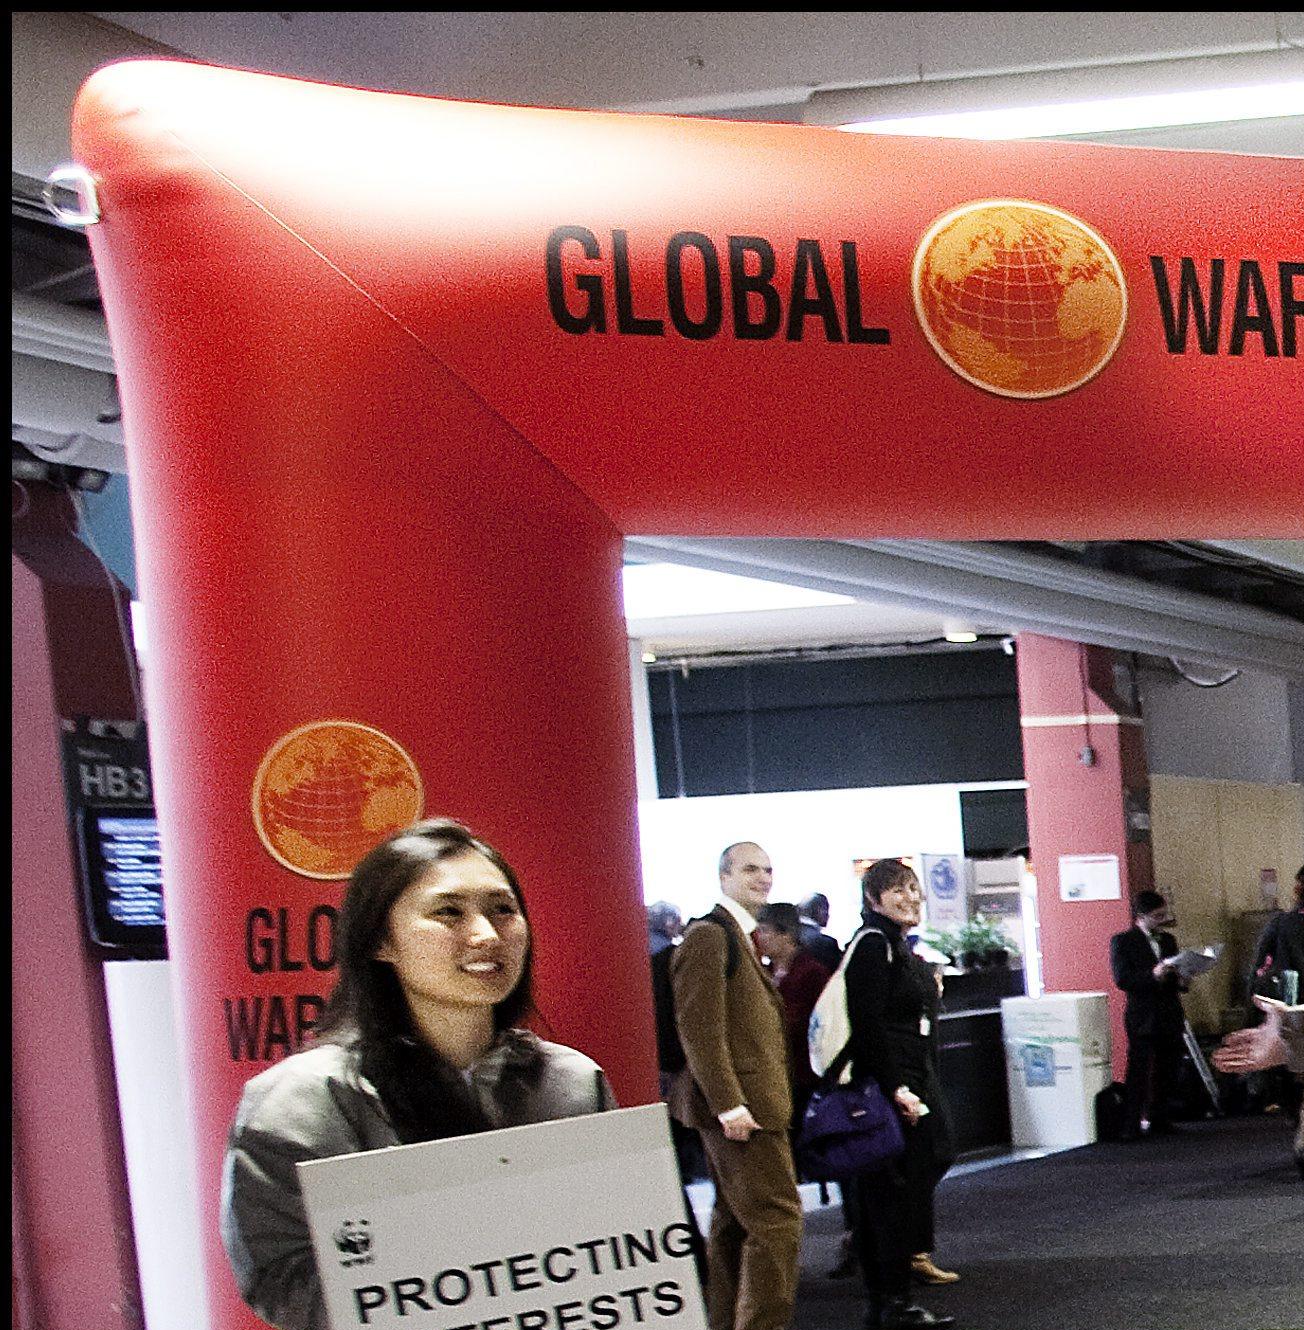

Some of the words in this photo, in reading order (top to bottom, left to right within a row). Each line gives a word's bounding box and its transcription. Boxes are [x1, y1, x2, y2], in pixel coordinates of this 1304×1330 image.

[542, 224, 892, 345] GLOBAL
[245, 904, 340, 974] GLO
[353, 1222, 697, 1325] PROTECTING
